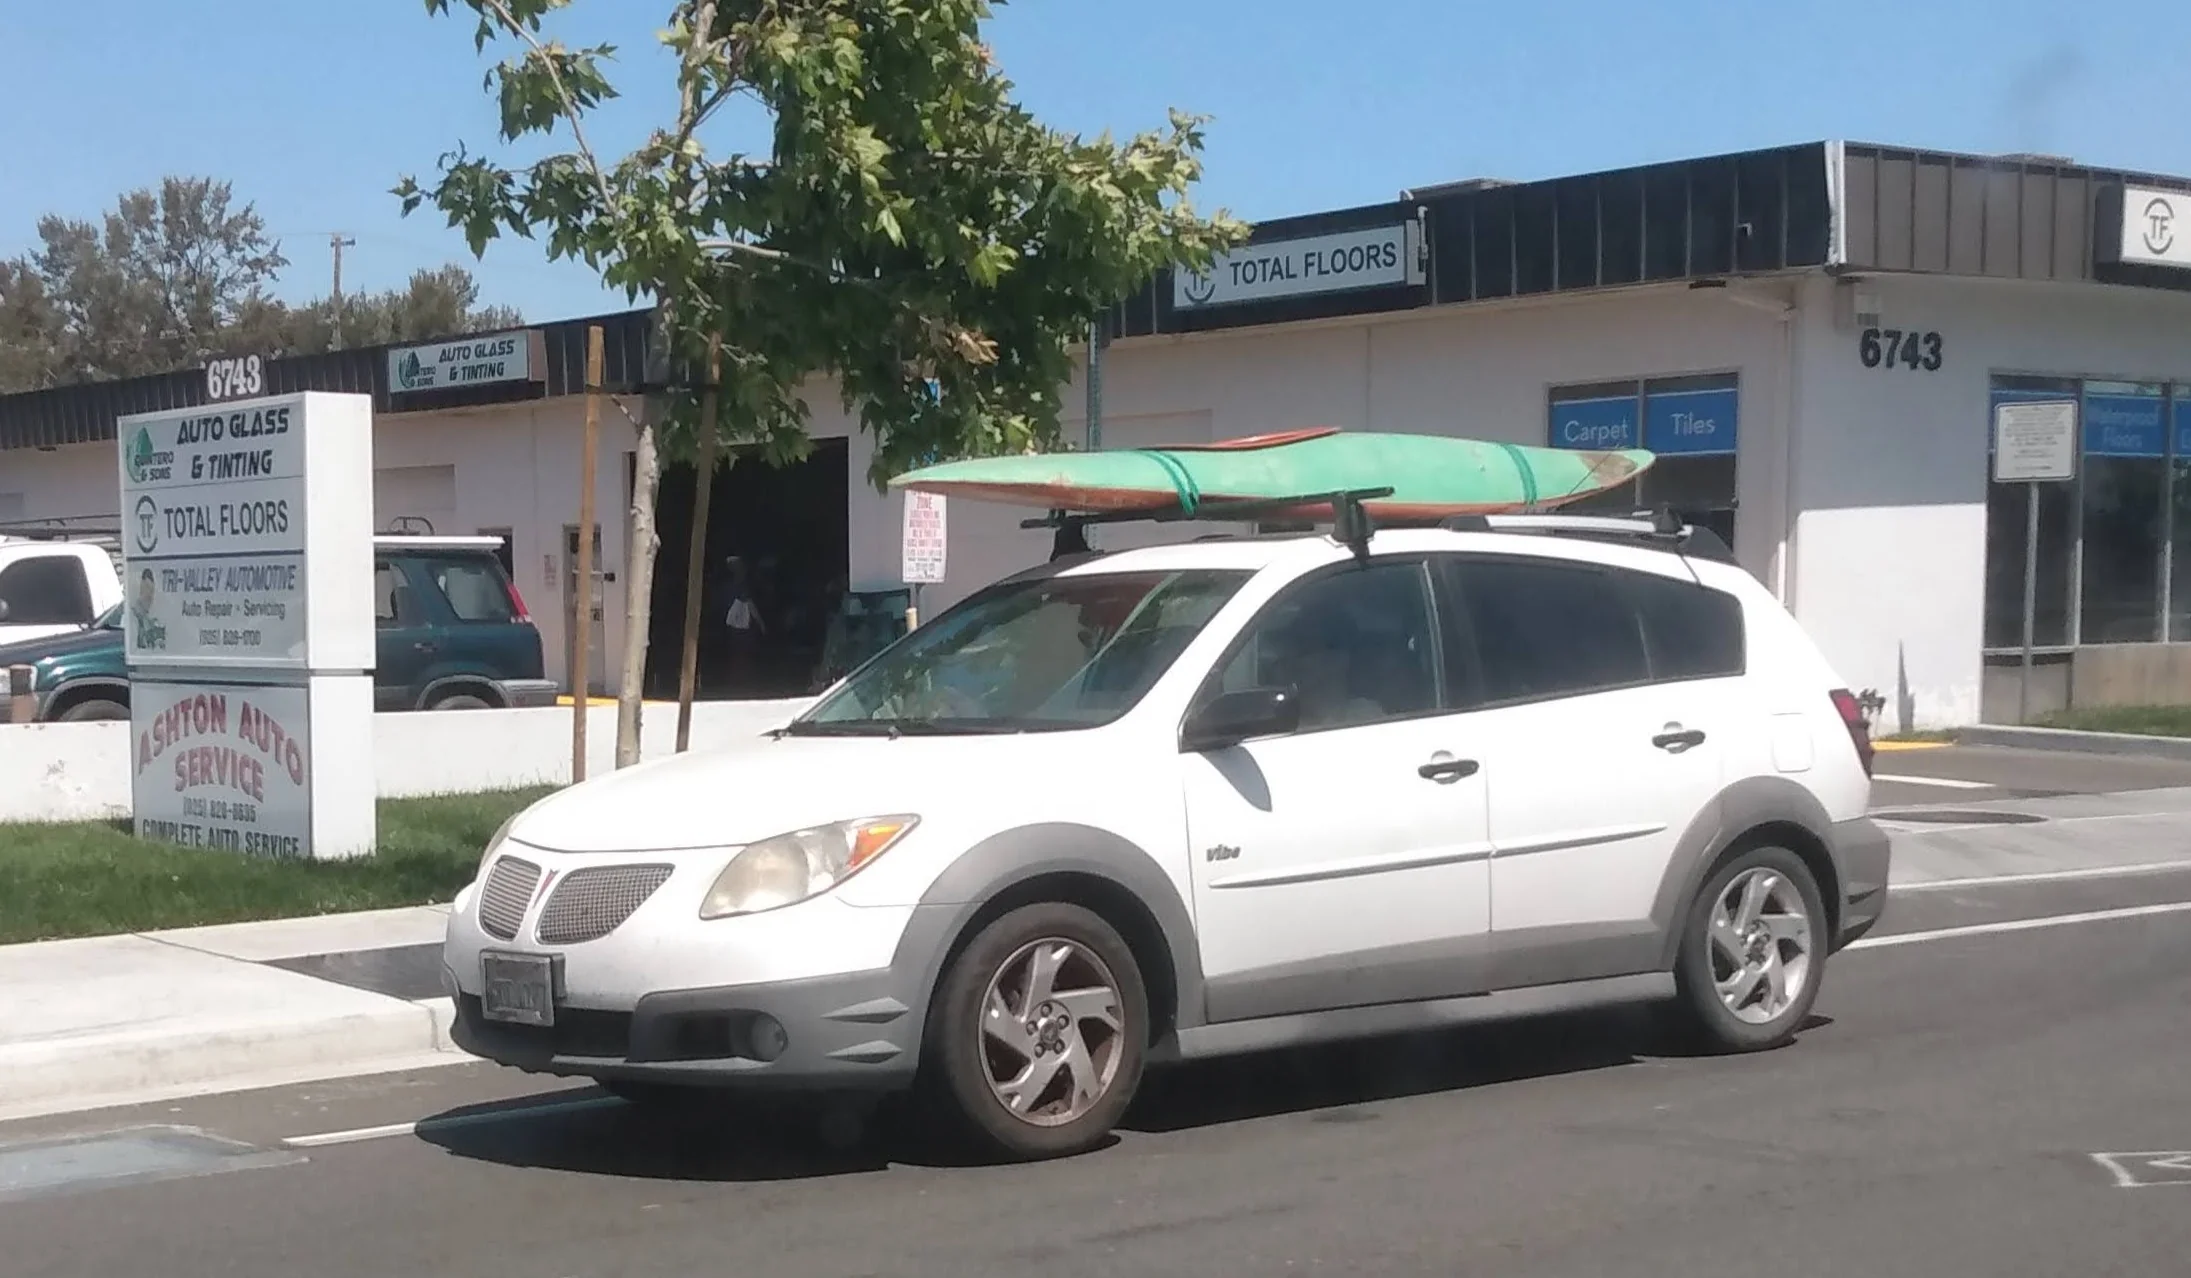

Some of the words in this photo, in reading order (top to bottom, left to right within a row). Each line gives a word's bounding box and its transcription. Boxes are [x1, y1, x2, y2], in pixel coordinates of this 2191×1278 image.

[1230, 255, 1297, 286] TOTAL
[1304, 241, 1398, 278] FLOORS
[438, 346, 471, 363] AUTO
[474, 339, 515, 359] GLASS
[1860, 328, 1943, 371] 6743
[207, 354, 262, 399] 6743
[449, 366, 459, 381] &
[461, 361, 505, 381] TINTING
[176, 415, 225, 445] AUTO
[229, 407, 290, 438] GLASS
[1564, 418, 1629, 445] Carpet
[1670, 411, 1716, 436] Tiles
[149, 466, 172, 482] SONS
[191, 455, 204, 480] &
[208, 449, 273, 480] TINTING
[164, 505, 216, 540] TOTAL
[220, 499, 288, 536] FLOORS
[162, 567, 223, 593] TRI-VALLEY
[225, 564, 297, 591] AUTOMOTIVE
[181, 599, 201, 617] Auto
[205, 599, 233, 619] Repair
[243, 599, 286, 620] Servicing
[139, 693, 227, 776] ASHTON
[239, 700, 304, 786] AUTO
[175, 745, 264, 804] SERVICE
[142, 818, 201, 847] COMPLETE
[207, 826, 239, 850] AUTO
[245, 831, 299, 854] SERVICE
